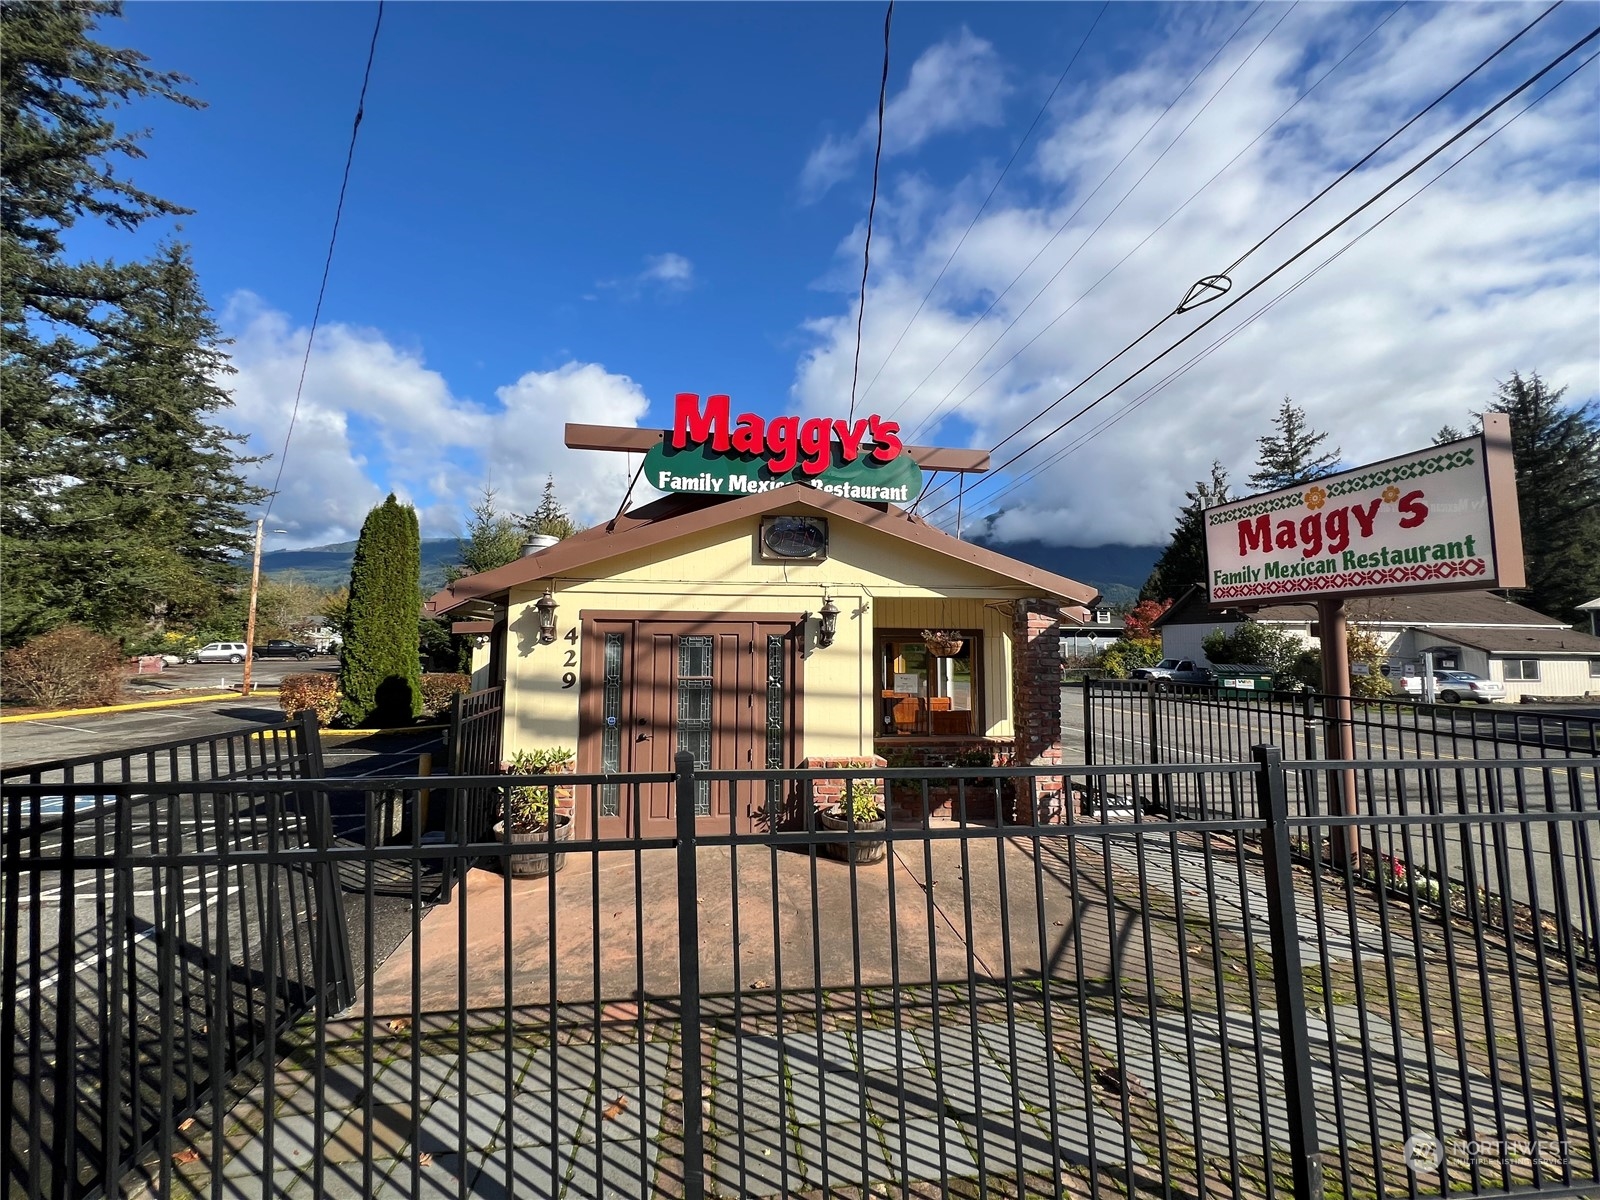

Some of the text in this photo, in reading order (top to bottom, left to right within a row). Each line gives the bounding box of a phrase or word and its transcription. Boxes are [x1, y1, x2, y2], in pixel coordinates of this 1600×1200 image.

[672, 393, 903, 475] Maggy's
[658, 471, 723, 493] Family
[811, 479, 909, 502] Restaurant
[769, 530, 817, 546] OPEN
[1213, 534, 1476, 587] Family Mexican Restaurant
